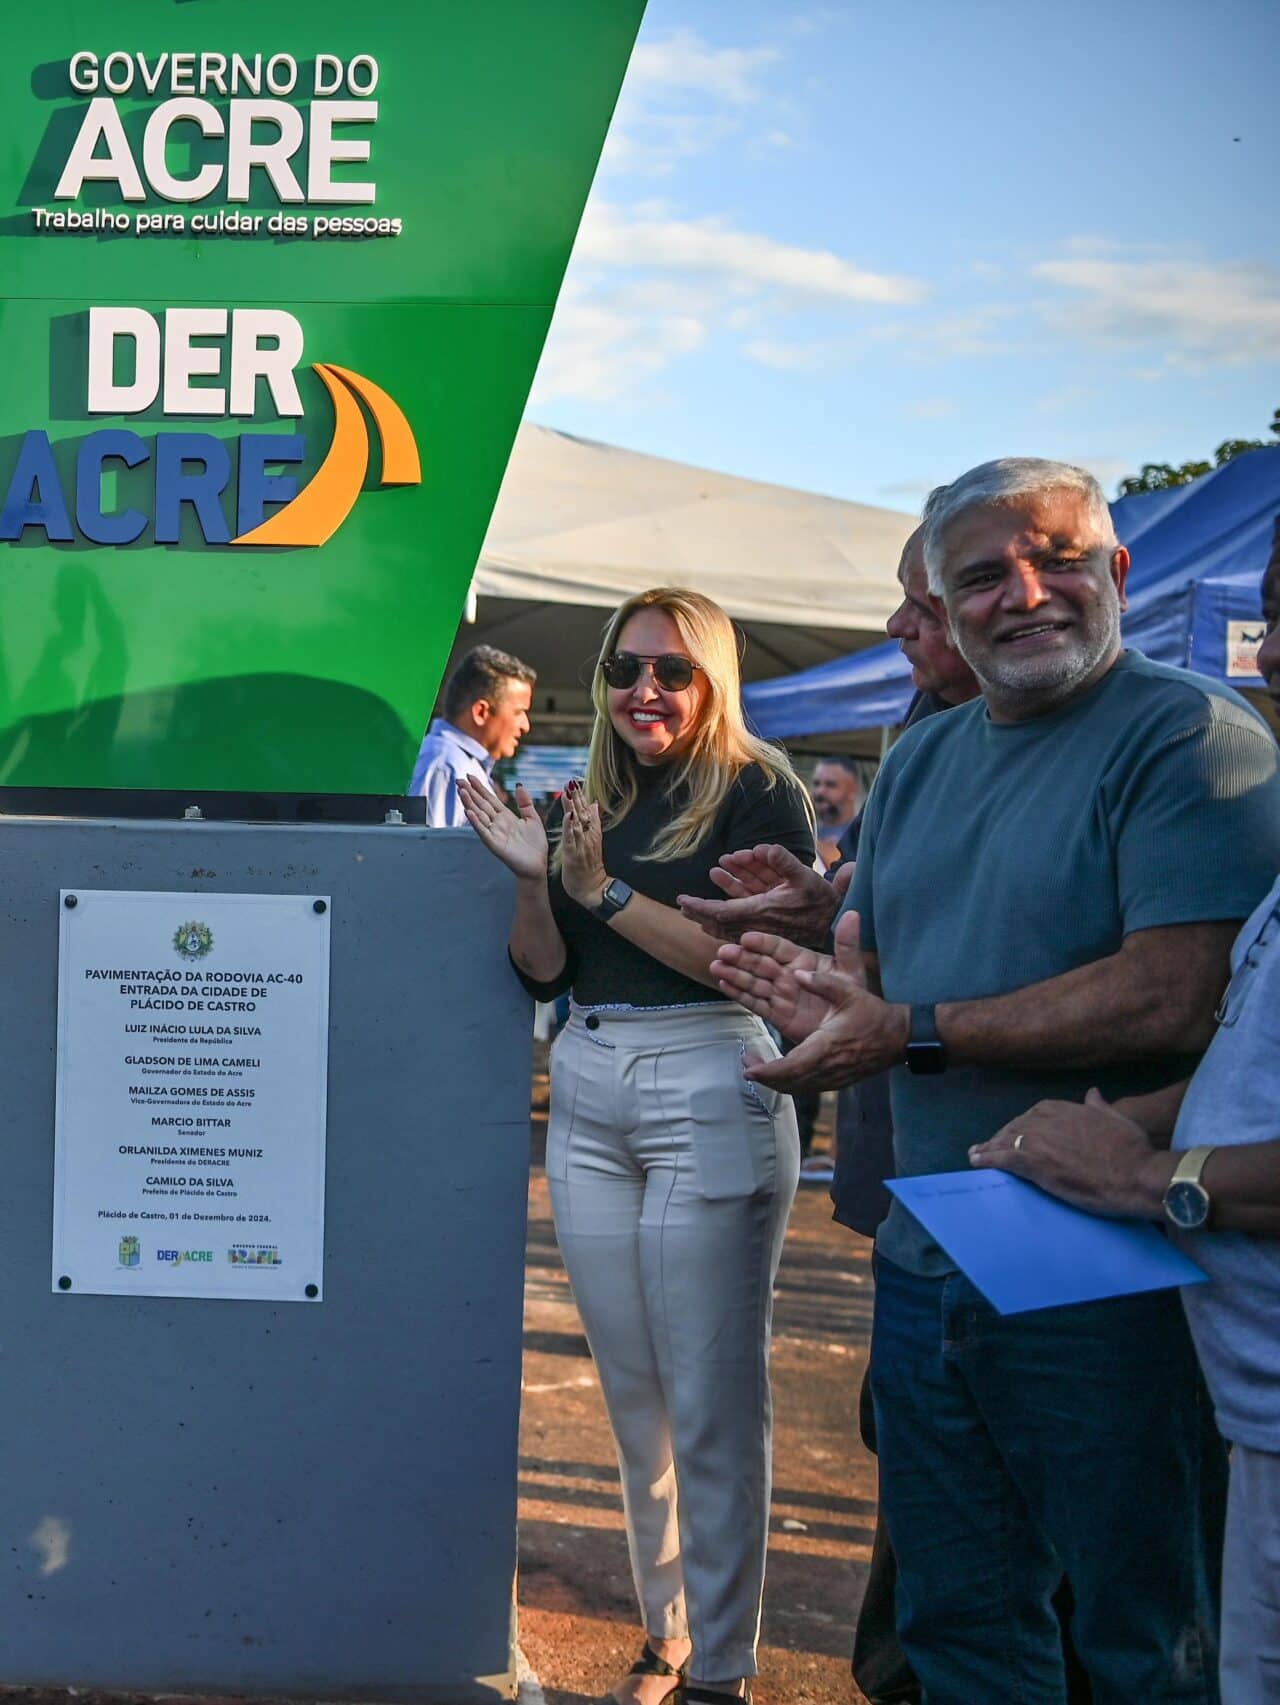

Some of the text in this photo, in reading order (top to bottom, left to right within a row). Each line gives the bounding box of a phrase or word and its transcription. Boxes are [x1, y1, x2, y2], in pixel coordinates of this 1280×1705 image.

[69, 51, 379, 97] GOVERNO DO
[53, 97, 379, 204] ACRE
[32, 208, 403, 239] Trabalho para cuidar das pessoas
[88, 306, 304, 417] DER
[85, 969, 303, 984] PAVIMENTAÇÃO DA RODOVIA AC-40
[119, 984, 268, 998] ENTRADA DA CIDADE DE
[130, 998, 256, 1012] PLÁCIDO DE CASTRO
[125, 1024, 262, 1036] LUIZ INÁCIO LULA DA SILVA
[153, 1036, 188, 1044] Presidente
[125, 1056, 261, 1068] GLADSON DE LIMA CAMELI
[128, 1086, 255, 1098] MAILZA GOMES DE ASSIS
[151, 1117, 231, 1128] MARCIO BITTAR
[118, 1145, 263, 1158] ORLANILDA XIMENES MUNIZ
[145, 1176, 234, 1187] CAMILO DA SILVA
[98, 1210, 127, 1218] Plácido
[128, 1211, 139, 1219] de
[140, 1211, 168, 1221] Castro,
[169, 1212, 179, 1220] 01
[193, 1213, 234, 1222] Dezembro
[235, 1214, 247, 1222] de
[248, 1214, 272, 1223] 2024.
[157, 1250, 213, 1262] DER ACRE
